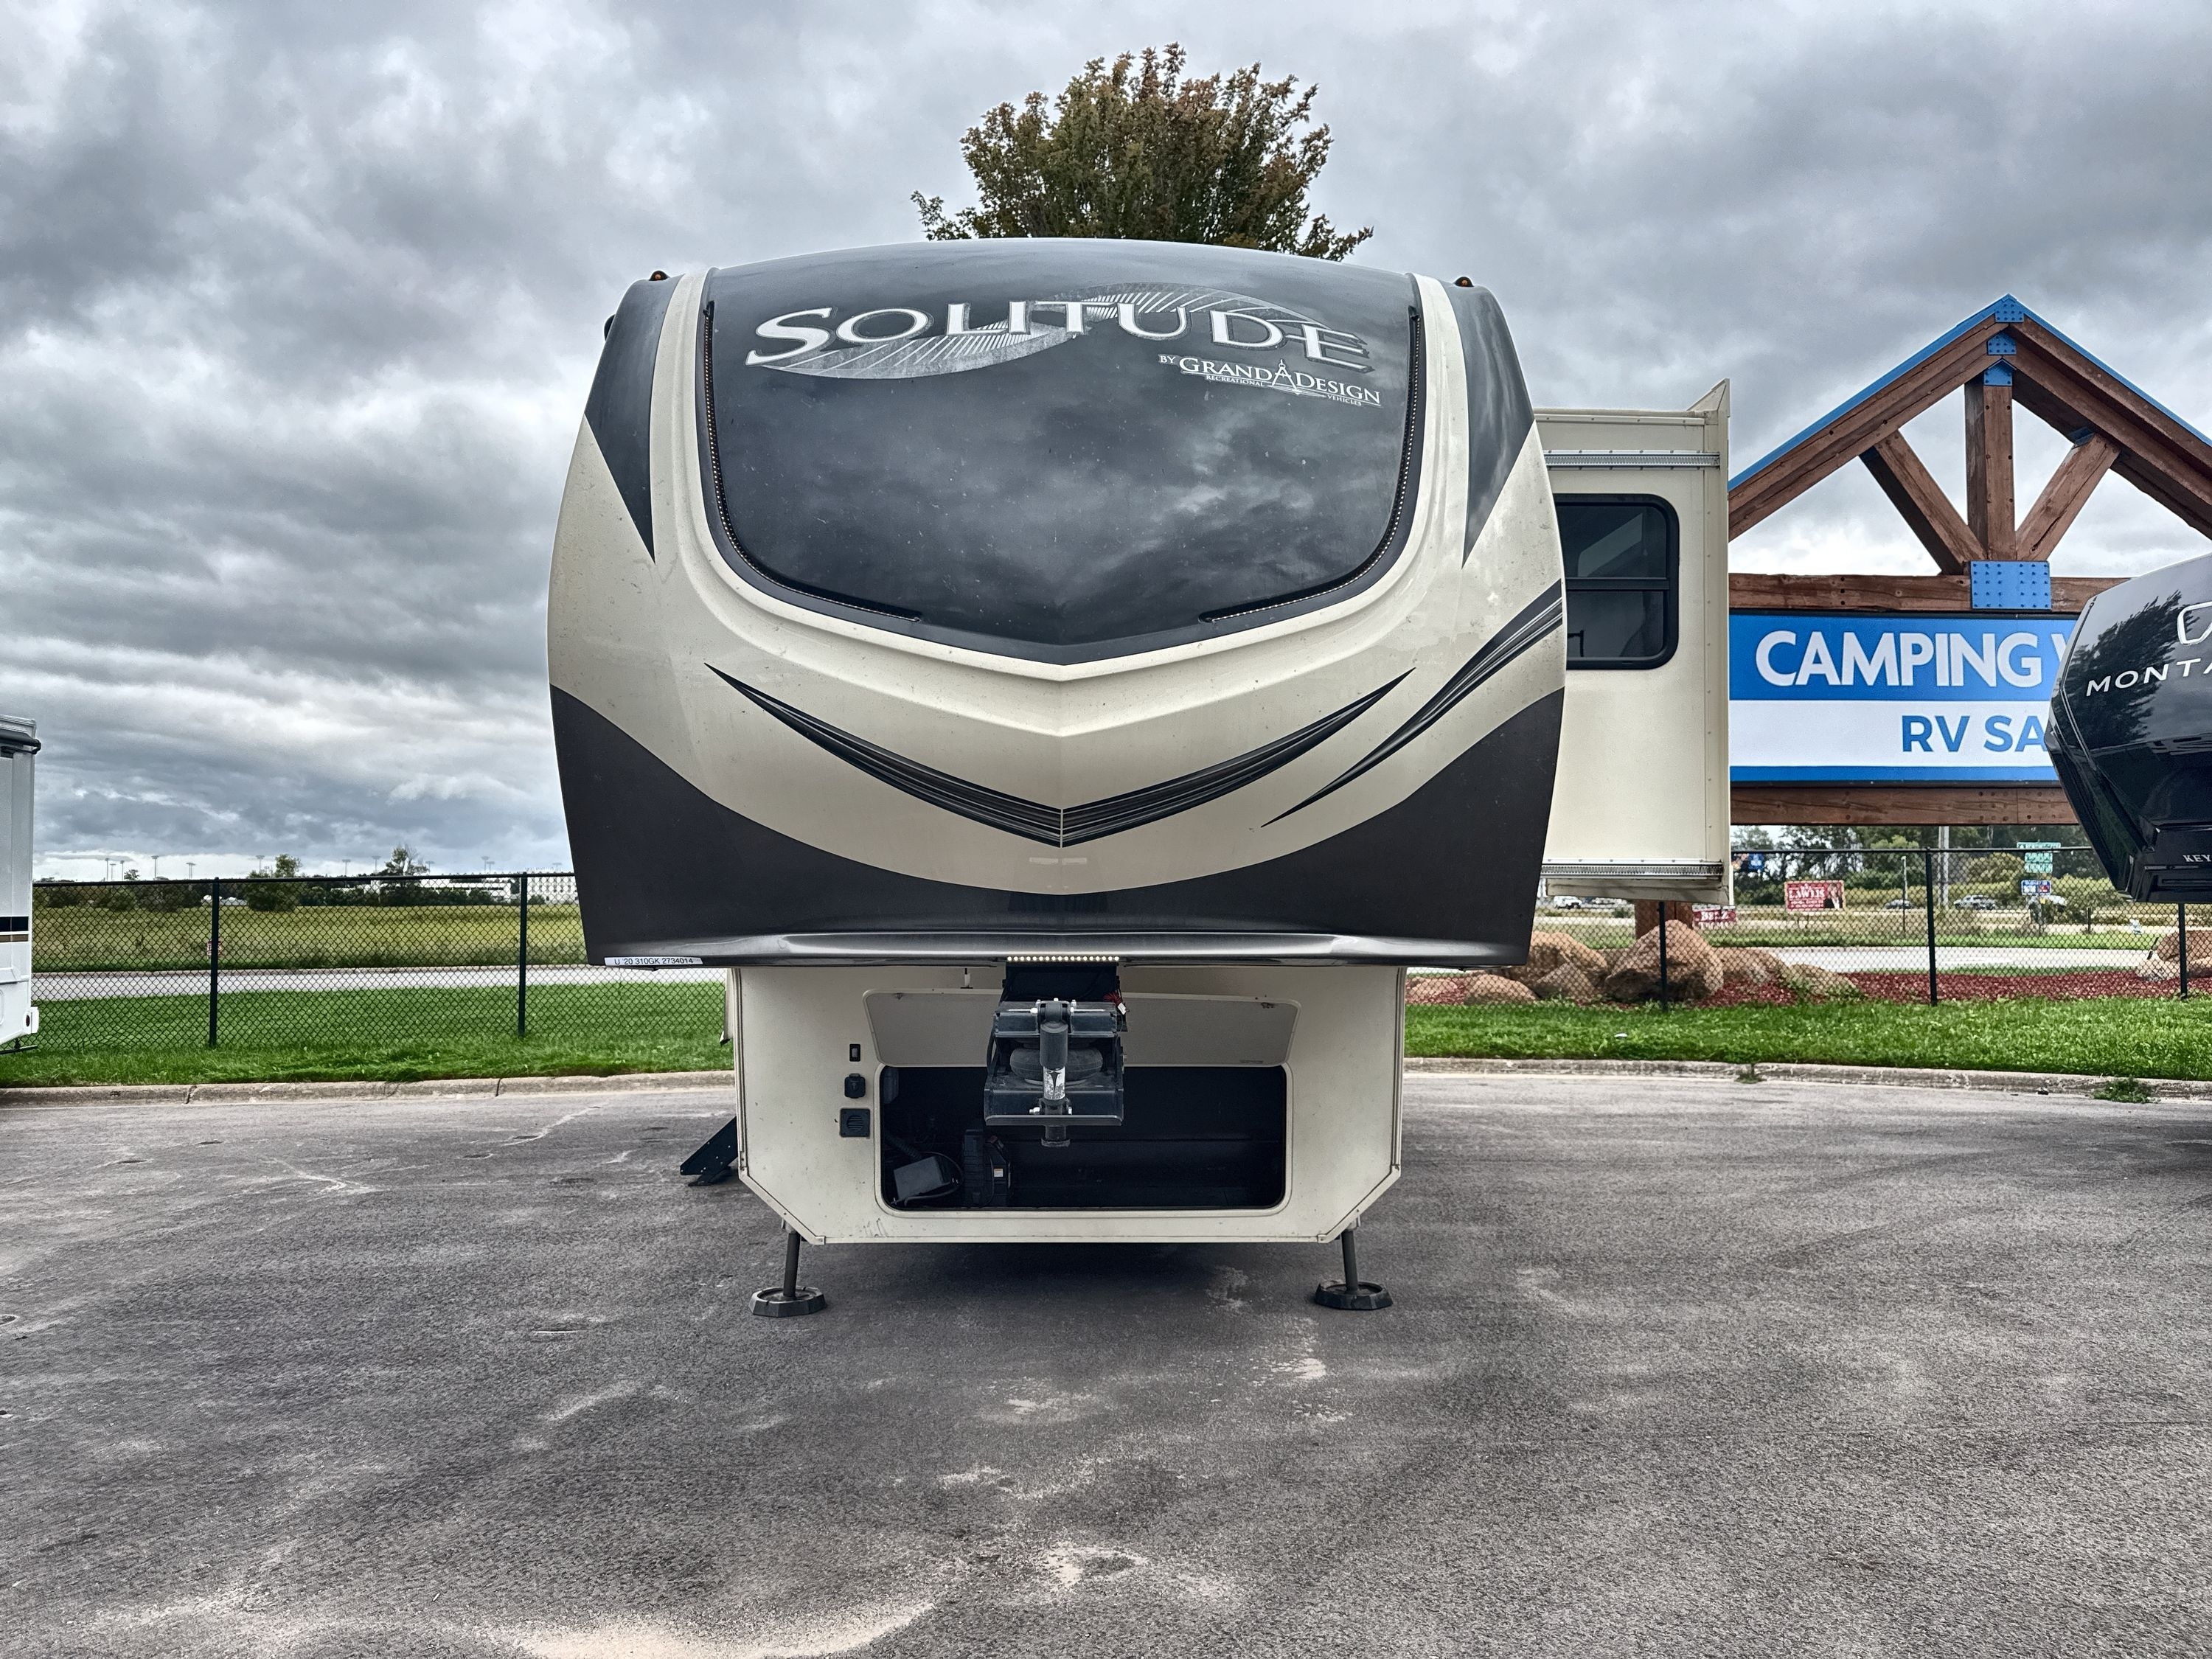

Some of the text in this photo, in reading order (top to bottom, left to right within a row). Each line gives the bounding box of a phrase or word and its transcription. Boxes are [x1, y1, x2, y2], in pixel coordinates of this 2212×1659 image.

[745, 300, 1374, 372] SOLITUDE
[1160, 355, 1381, 404] BY GRAND DESIGN
[1206, 375, 1362, 406] RECREATIONAL VEHICLES
[1755, 629, 2042, 688] CAMPING
[1902, 715, 1971, 753] RV
